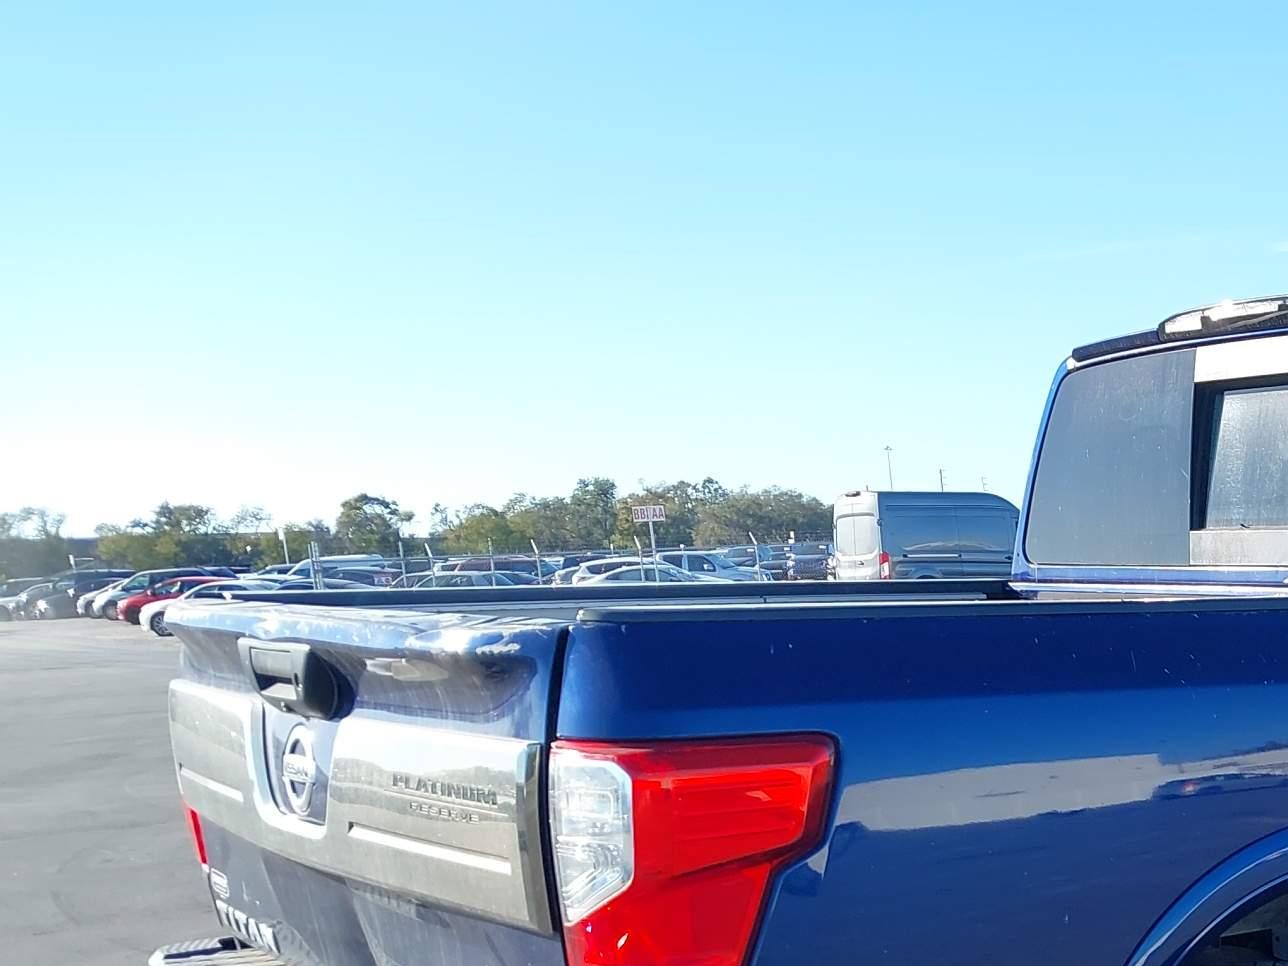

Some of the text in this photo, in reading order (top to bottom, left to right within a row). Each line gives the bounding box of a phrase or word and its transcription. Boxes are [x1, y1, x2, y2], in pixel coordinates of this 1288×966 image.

[392, 772, 499, 808] PLATINUM
[409, 800, 480, 825] RESERVE
[215, 899, 280, 954] TITAN
